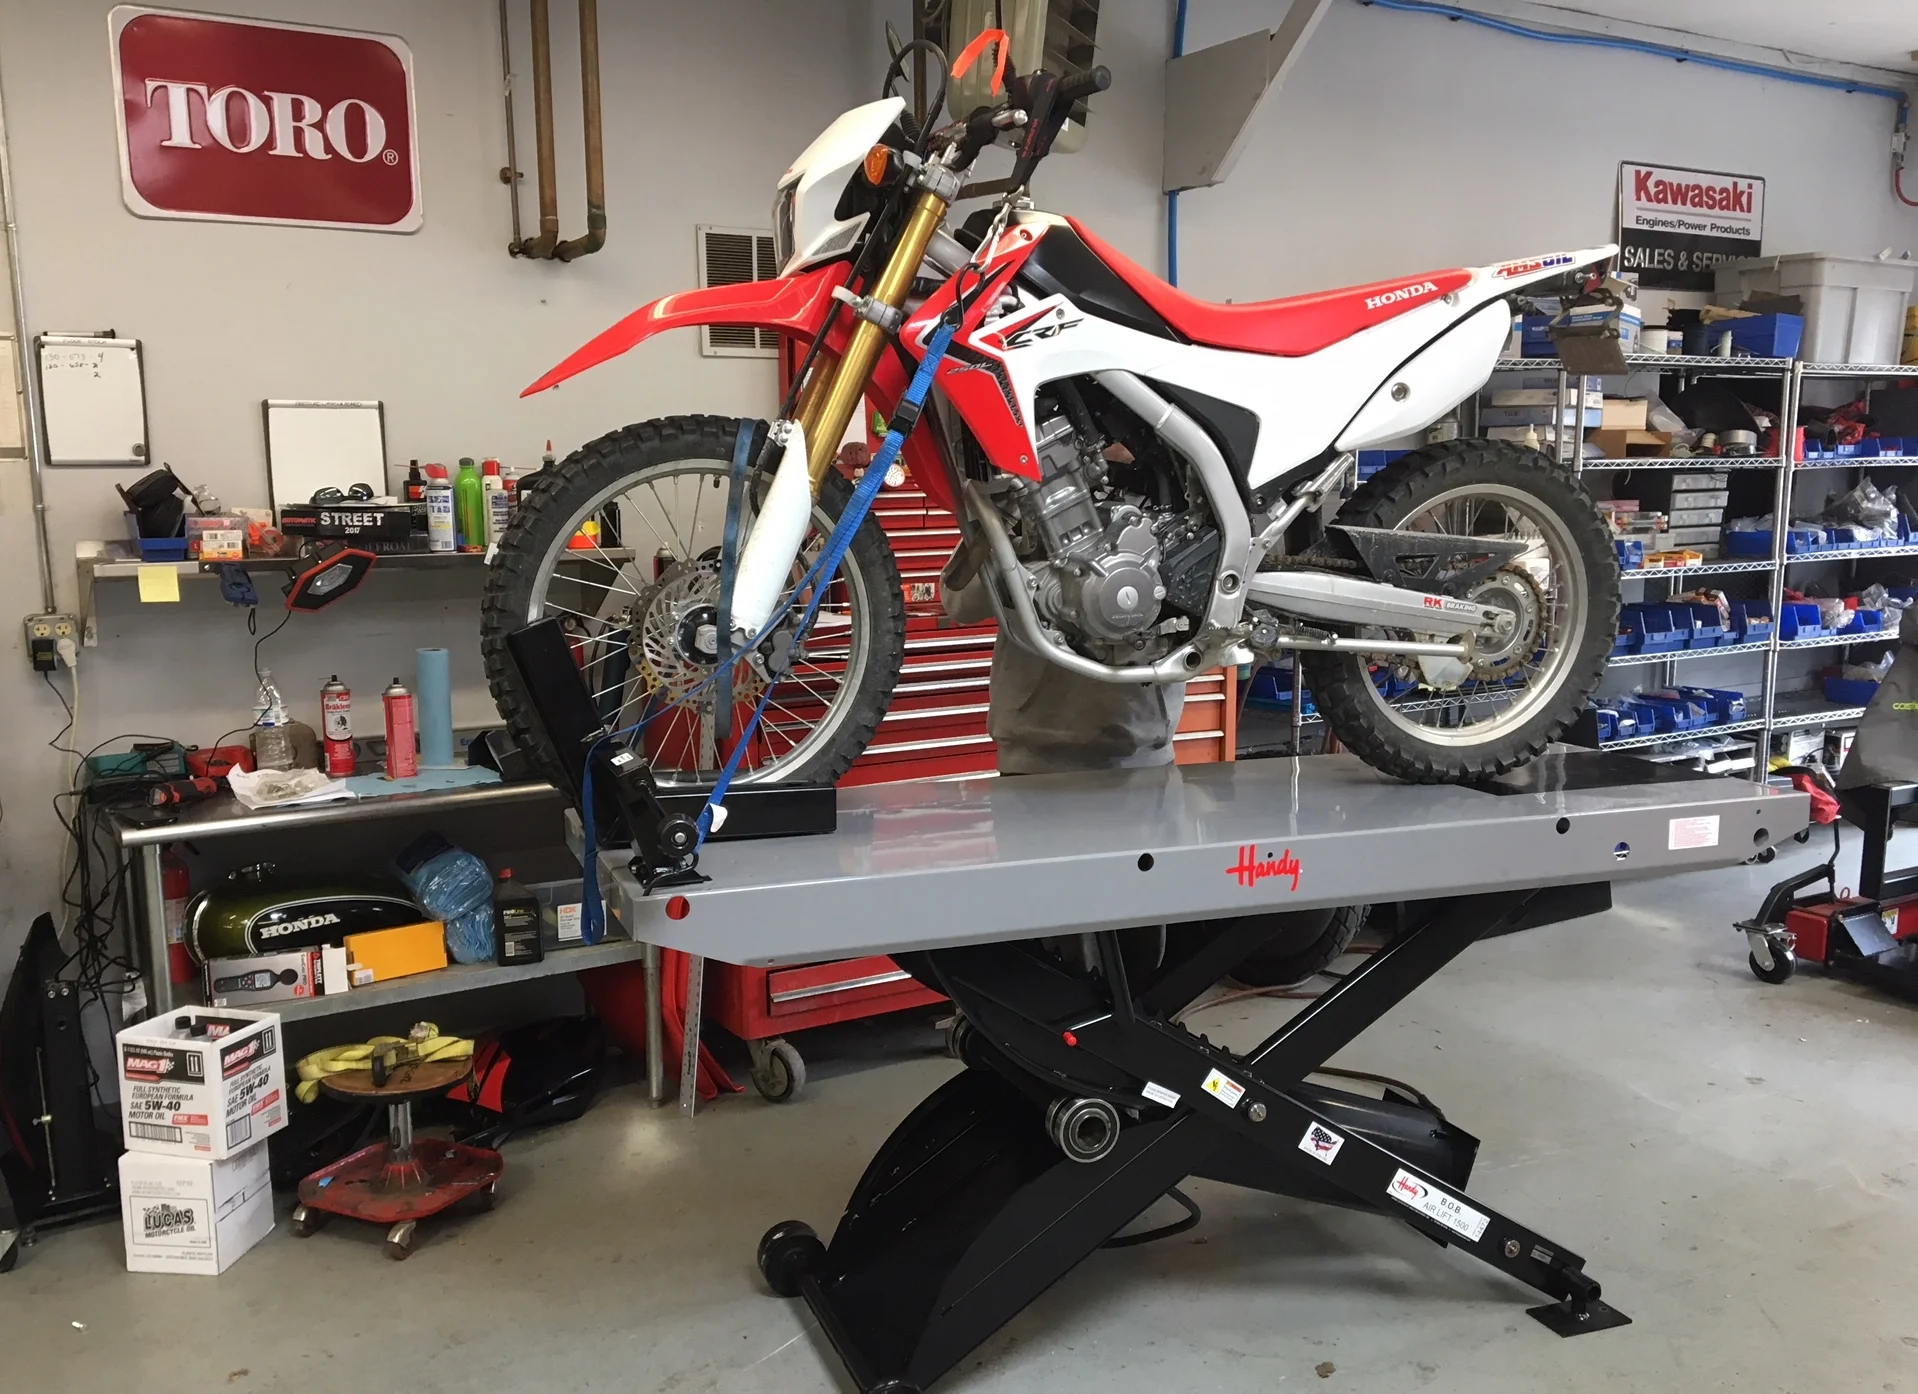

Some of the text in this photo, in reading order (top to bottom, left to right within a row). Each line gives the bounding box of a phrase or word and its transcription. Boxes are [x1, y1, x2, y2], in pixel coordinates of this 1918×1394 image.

[145, 77, 387, 163] TORO
[1634, 169, 1753, 214] Kawasaki
[1635, 215, 1751, 236] Engines/Power Products
[1623, 245, 1674, 271] SALES
[1677, 247, 1689, 271] &
[1364, 281, 1439, 310] HONDA
[1002, 318, 1085, 351] CRF
[320, 512, 385, 526] STREET
[1424, 596, 1443, 608] RK
[1225, 844, 1299, 892] Handy
[260, 912, 341, 939] HONDA
[131, 1092, 194, 1101] EUROPEAN FORMULA
[133, 1085, 181, 1094] FULL SYNTHETIC
[239, 1074, 269, 1100] 5W-40
[128, 1110, 166, 1120] MOTOR OIL
[130, 1100, 182, 1112] SAE 5W-40
[226, 1099, 247, 1118] MOTOR
[1396, 1175, 1419, 1201] Handy
[1422, 1201, 1470, 1232] AIR LIFT 1500
[1440, 1197, 1462, 1216] B.O.B.
[144, 1208, 195, 1232] LUCAS
[145, 1226, 185, 1239] MOTORCYCLE
